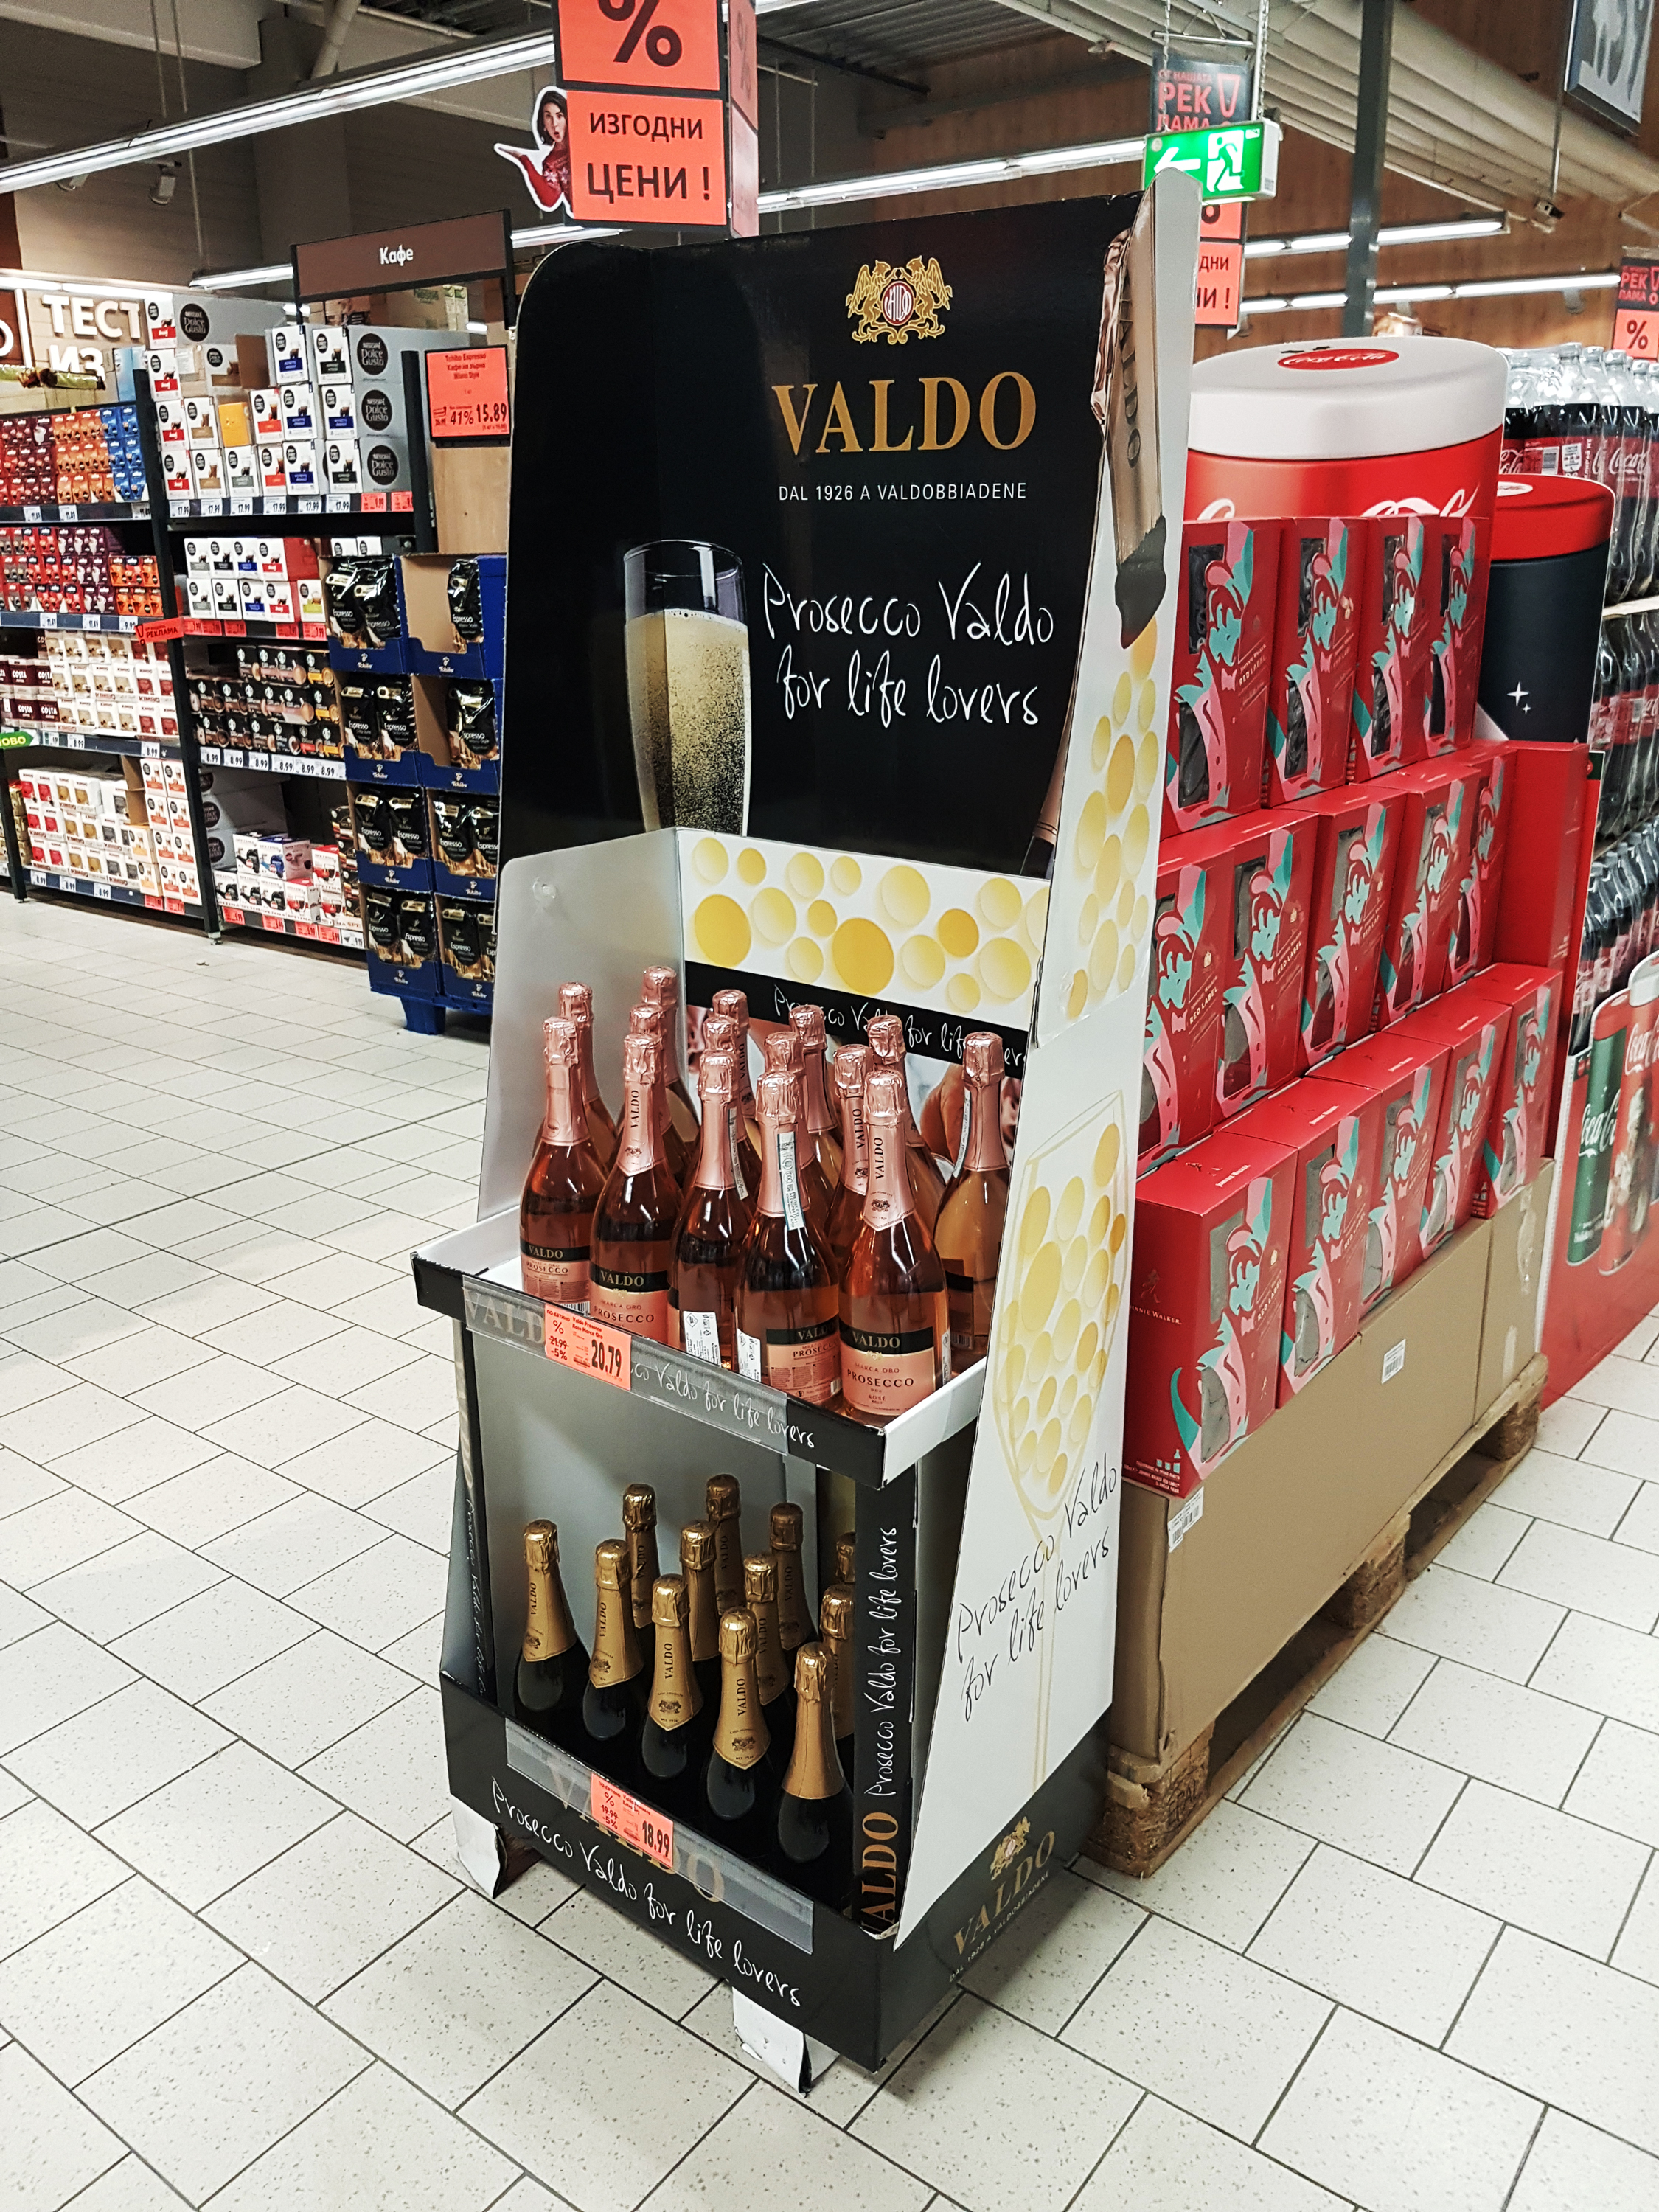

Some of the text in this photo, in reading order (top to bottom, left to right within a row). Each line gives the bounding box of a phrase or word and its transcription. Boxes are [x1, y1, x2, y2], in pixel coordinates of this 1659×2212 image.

[598, 0, 682, 67] %
[1158, 82, 1213, 115] РЕК
[589, 112, 703, 142] ИЗГОДНИ
[587, 162, 687, 204] ЦЕНИ
[379, 245, 414, 267] Кафе
[1621, 271, 1649, 290] РЕК
[41, 294, 142, 340] ТЕСТ
[1627, 320, 1649, 350] %
[49, 344, 106, 381] ИЗ
[450, 411, 474, 425] 41%
[476, 403, 507, 423] 15.89
[771, 371, 1037, 456] VALDO
[779, 482, 1027, 501] DAL 1926 A VALDOBBIADENE
[306, 502, 319, 512] 17.99
[335, 501, 349, 511] 17.99
[762, 561, 1054, 647] Prosecco Valdo
[146, 627, 178, 639] РЕКЛАМА
[12, 670, 27, 679] COSTA
[1239, 672, 1250, 686] RED
[776, 644, 1039, 728] for life lovers
[18, 705, 33, 714] COSTA
[41, 706, 58, 715] COSTA
[349, 720, 369, 730] Espresso
[384, 722, 407, 731] Espresso
[206, 754, 218, 762] 8.99
[230, 756, 243, 765] 8.99
[255, 758, 268, 768] 8.99
[279, 761, 293, 772] 8.99
[302, 765, 315, 775] 8.99
[321, 766, 335, 777] 8.99
[361, 827, 382, 836] Espresso
[397, 830, 420, 841] Espresso
[440, 838, 462, 848] Espresso
[405, 933, 426, 942] Espresso
[451, 942, 471, 952] Espresso
[1277, 940, 1302, 975] RED LABEL
[1189, 987, 1218, 1025] RED LABEL
[940, 1020, 966, 1060] lif
[630, 1089, 640, 1129] VALDO
[852, 1107, 866, 1150] VALDO
[874, 1136, 884, 1180] VALDO
[527, 1245, 564, 1260] VALDO
[599, 1270, 645, 1287] VALDO
[593, 1305, 655, 1324] PROSECCO
[1152, 1310, 1183, 1325] WALKER
[1258, 1303, 1268, 1321] RED
[553, 1320, 564, 1335] %
[852, 1330, 901, 1349] VALDO
[551, 1348, 568, 1361] -5%
[591, 1338, 622, 1377] 20.79
[847, 1368, 914, 1388] PROSECCO
[657, 1362, 698, 1400] Valdo
[705, 1381, 726, 1411] for
[734, 1392, 759, 1429] life
[767, 1407, 815, 1448] lovers
[958, 1452, 1118, 1665] Prosecco Valdo
[599, 1601, 608, 1638] VALDO
[961, 1526, 1110, 1722] for life lovers
[664, 1643, 674, 1680] VALDO
[737, 1677, 747, 1717] VALDO
[861, 1527, 902, 1927] ALDO Prosecco Valdo for life lovers
[605, 1792, 615, 1806] %
[602, 1815, 618, 1829] -5%
[641, 1820, 669, 1857] 18.99
[492, 1775, 574, 1858] Prosecco
[579, 1840, 638, 1901] Valdo
[644, 1882, 676, 1926] for
[686, 1910, 723, 1959] life
[734, 1940, 801, 2006] lovers
[953, 1830, 1056, 1955] VALDO
